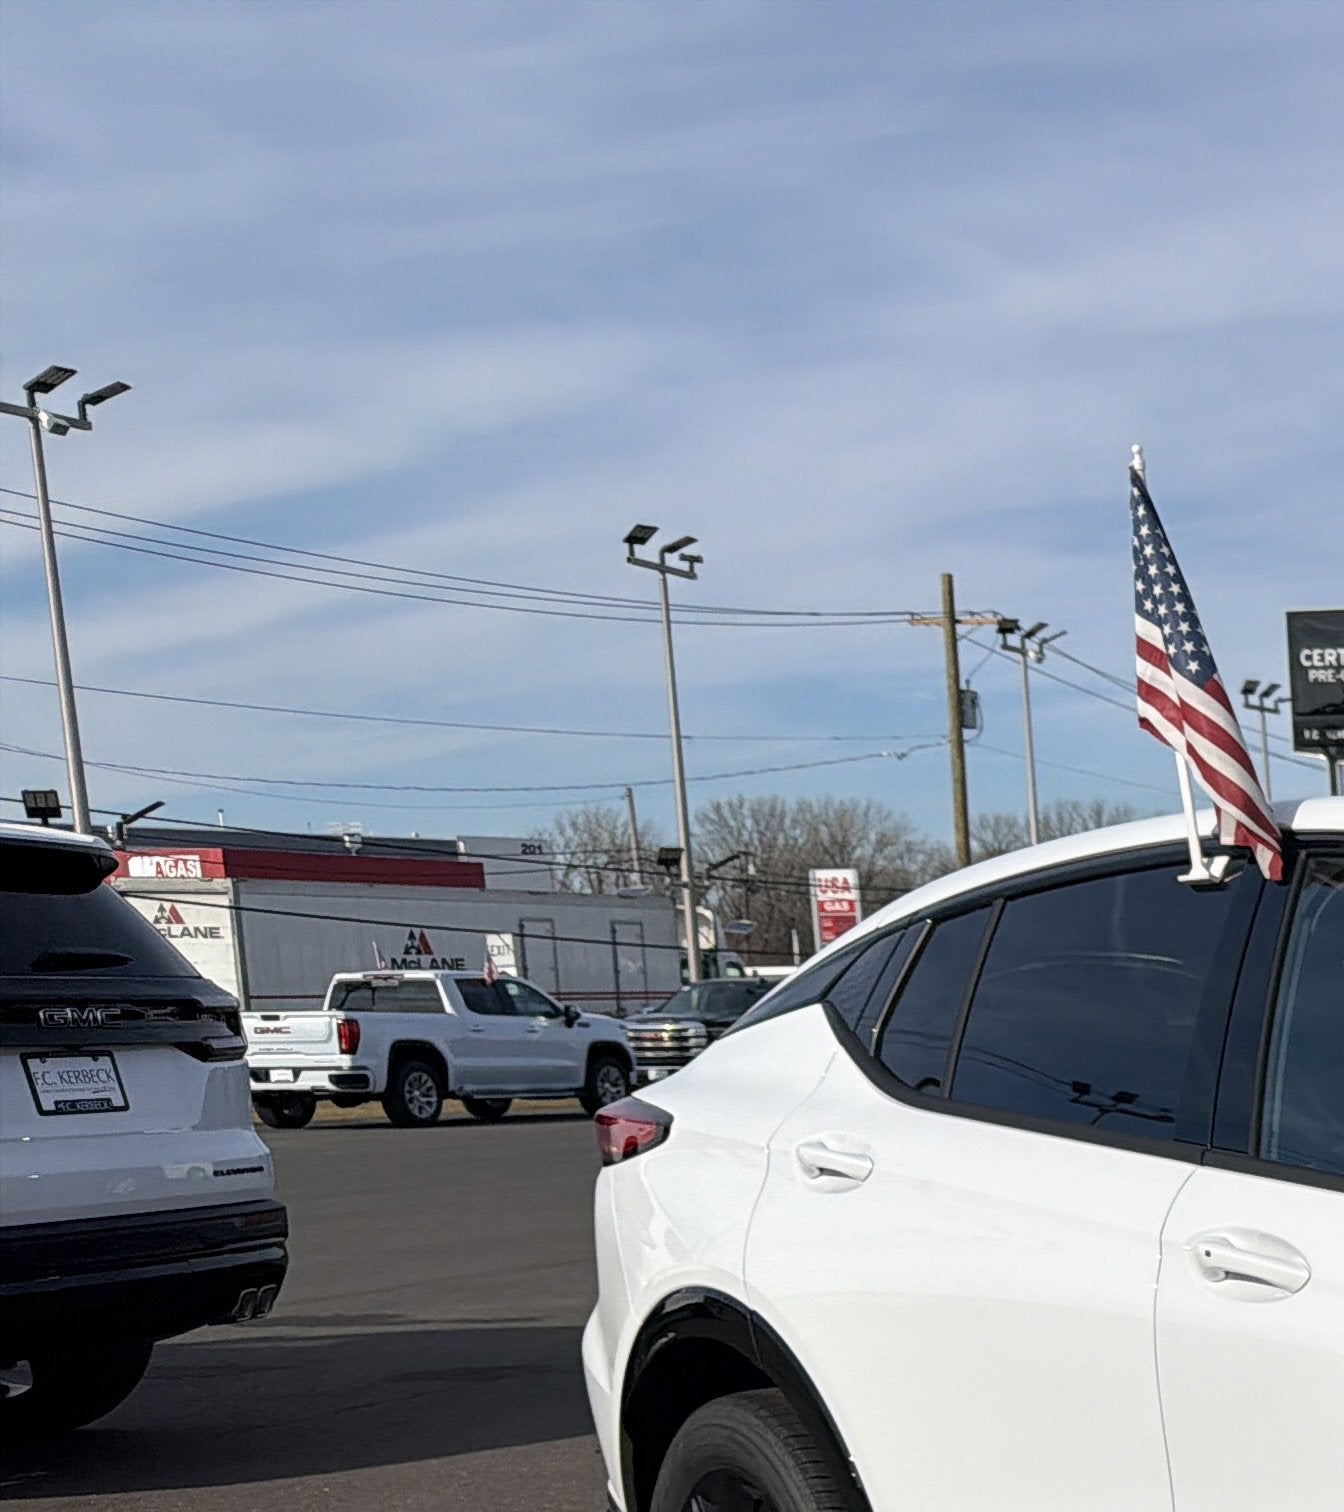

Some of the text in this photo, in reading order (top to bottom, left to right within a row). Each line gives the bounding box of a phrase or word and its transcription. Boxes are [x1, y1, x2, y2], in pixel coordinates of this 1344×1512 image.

[521, 843, 544, 856] 201
[165, 859, 196, 878] GAS
[816, 876, 851, 894] USA
[158, 926, 222, 939] cLANE
[391, 957, 465, 970] McLANE
[39, 1007, 122, 1028] GMC
[254, 1026, 291, 1034] GMC
[33, 1068, 115, 1086] F.C. KERBECK
